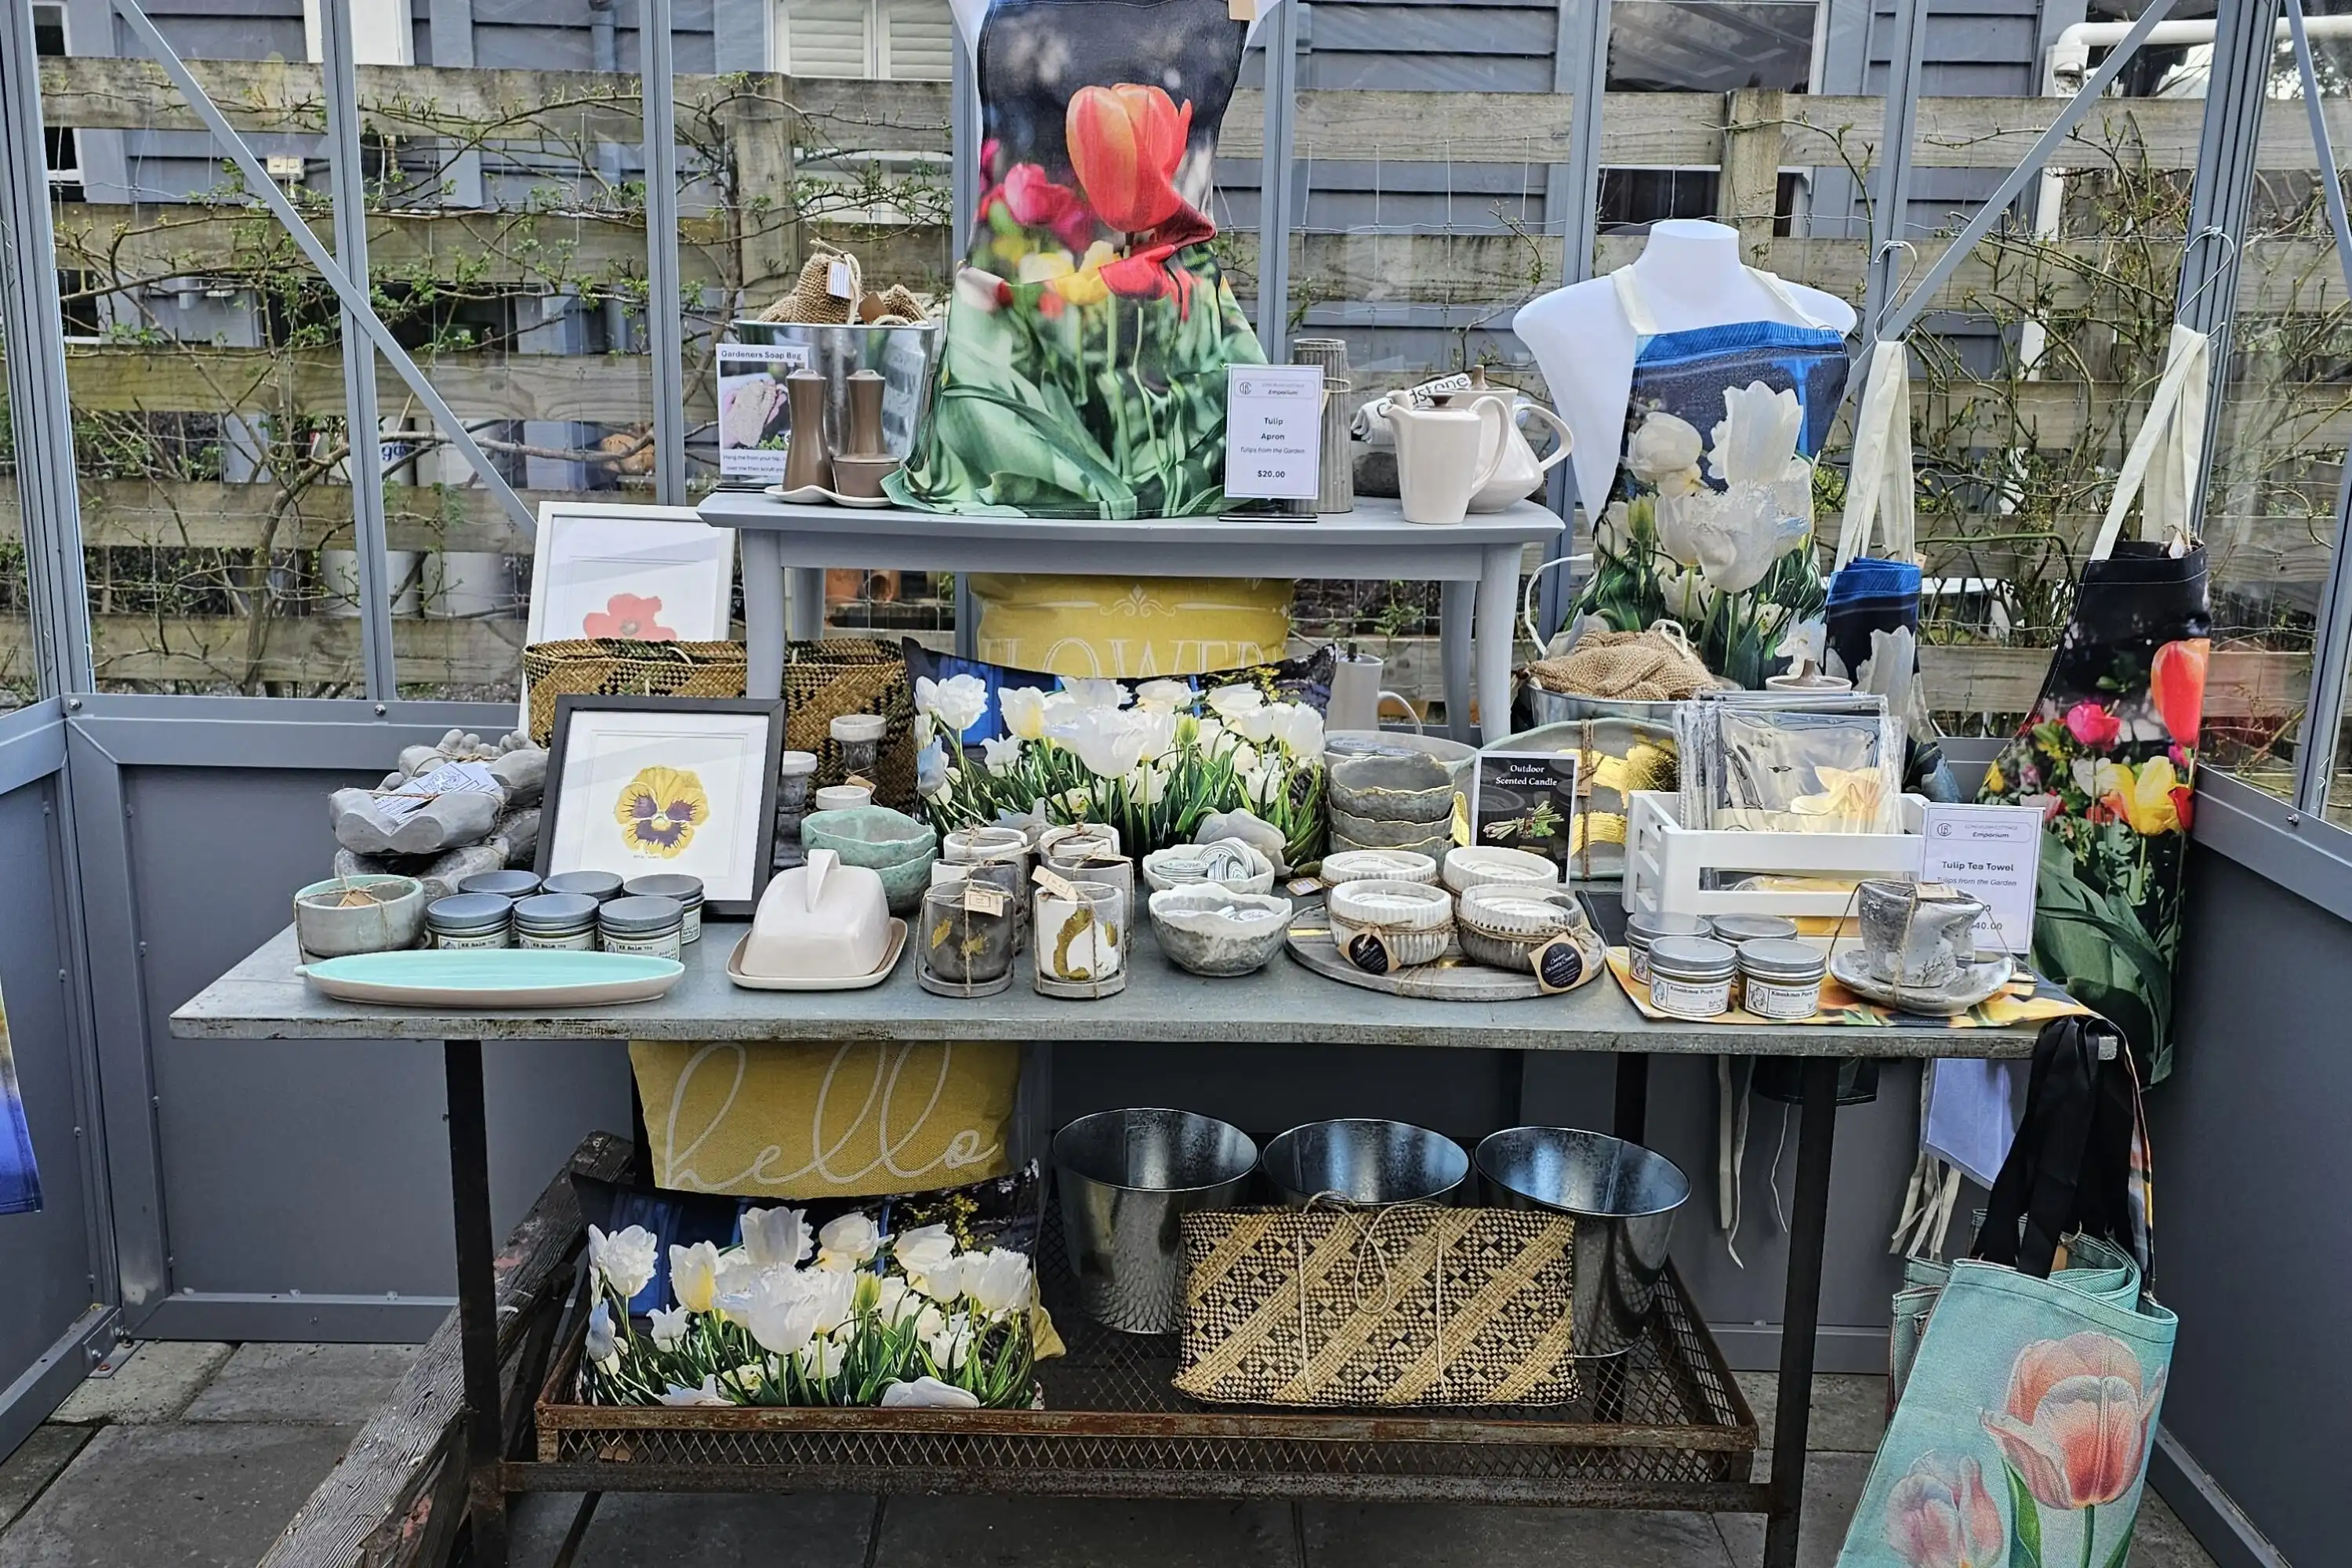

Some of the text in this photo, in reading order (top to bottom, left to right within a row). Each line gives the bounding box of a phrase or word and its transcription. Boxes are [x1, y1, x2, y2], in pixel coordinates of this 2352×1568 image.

[721, 350, 802, 361] Gardeners Soap Bag
[1265, 417, 1283, 426] Tulip
[1257, 470, 1285, 478] $20.00
[1510, 764, 1545, 773] Outdoor
[1495, 776, 1558, 786] Scented Candle
[1942, 861, 2014, 871] Tulip Tea Towel
[665, 1041, 999, 1190] hello
